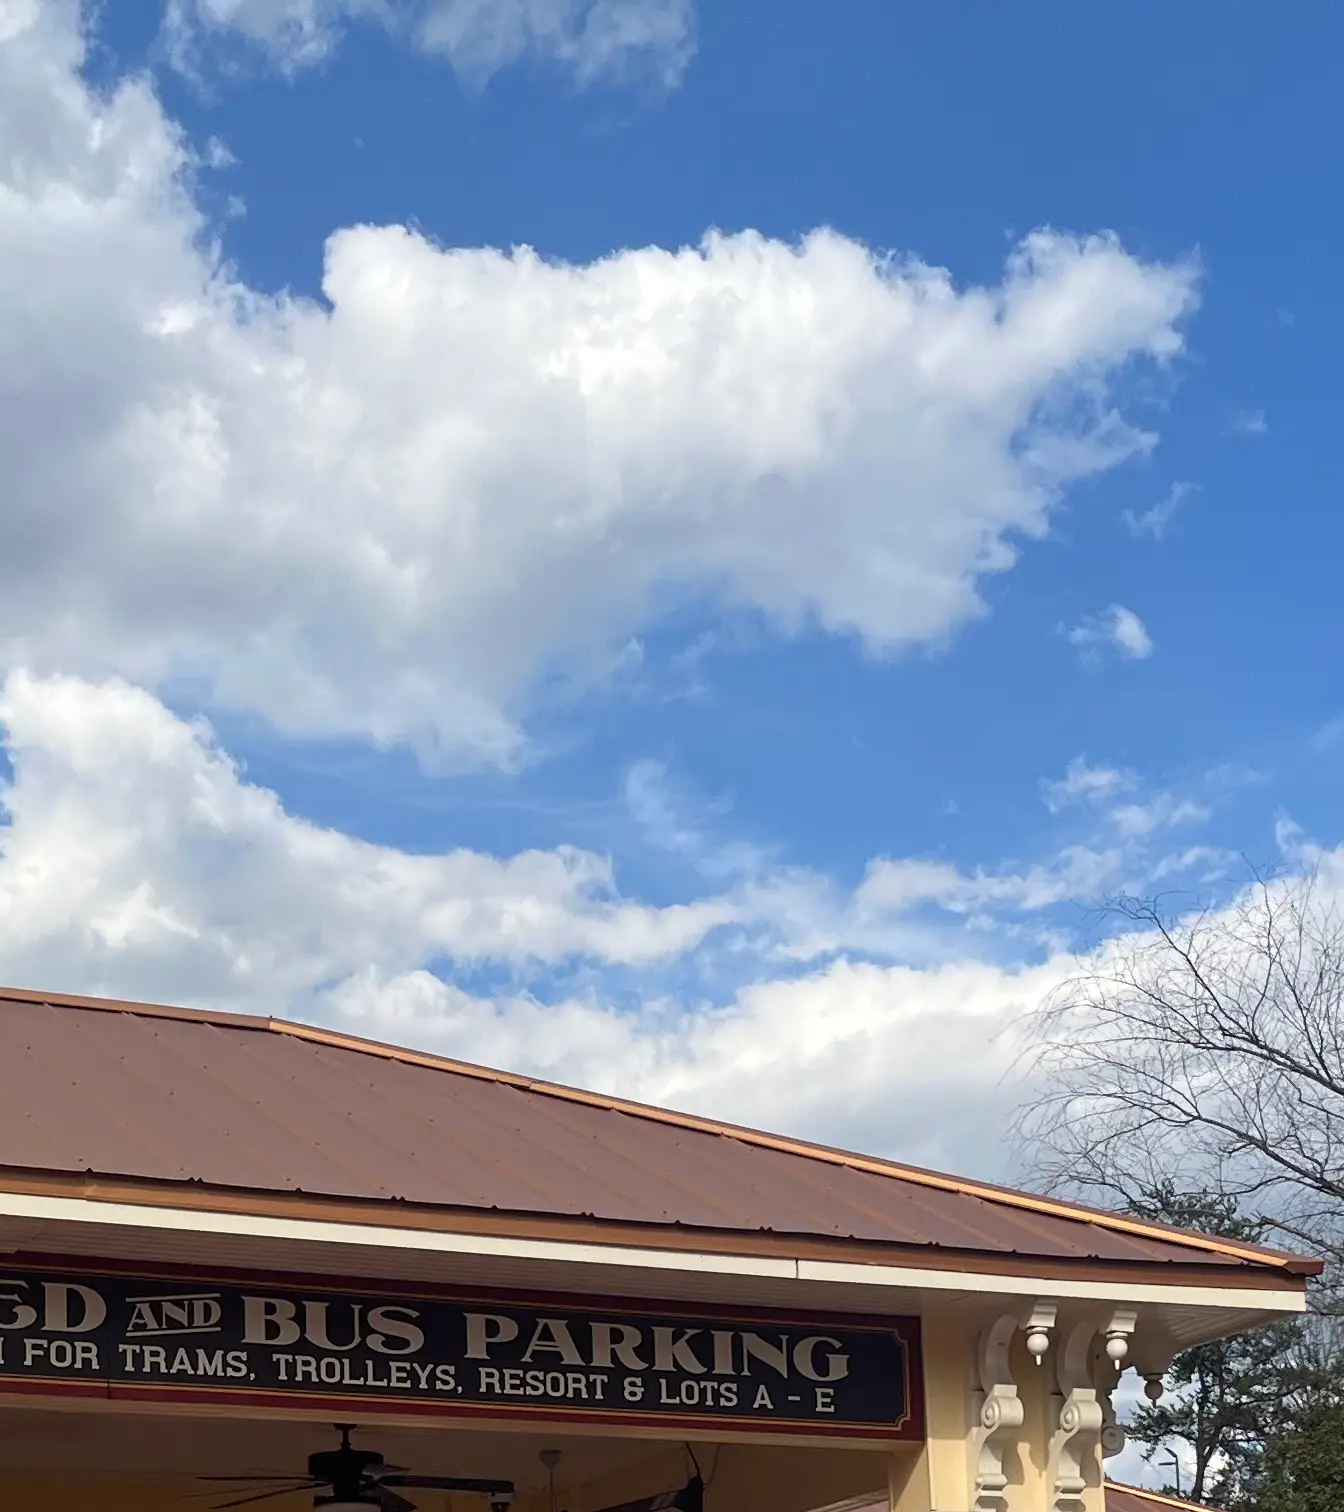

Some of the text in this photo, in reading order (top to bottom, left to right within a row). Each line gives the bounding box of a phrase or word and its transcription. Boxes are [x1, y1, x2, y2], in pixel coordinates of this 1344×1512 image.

[24, 1338, 100, 1370] FOR
[118, 1343, 256, 1381] TRAMS,
[272, 1353, 463, 1394] TROLLEYS,
[479, 1367, 608, 1400] RESORT
[623, 1377, 645, 1401] &
[659, 1378, 738, 1406] LOTS
[752, 1385, 774, 1410] A
[815, 1387, 835, 1413] E
[126, 1299, 222, 1332] AND
[241, 1295, 425, 1354] BUS
[462, 1312, 850, 1382] PARKING
